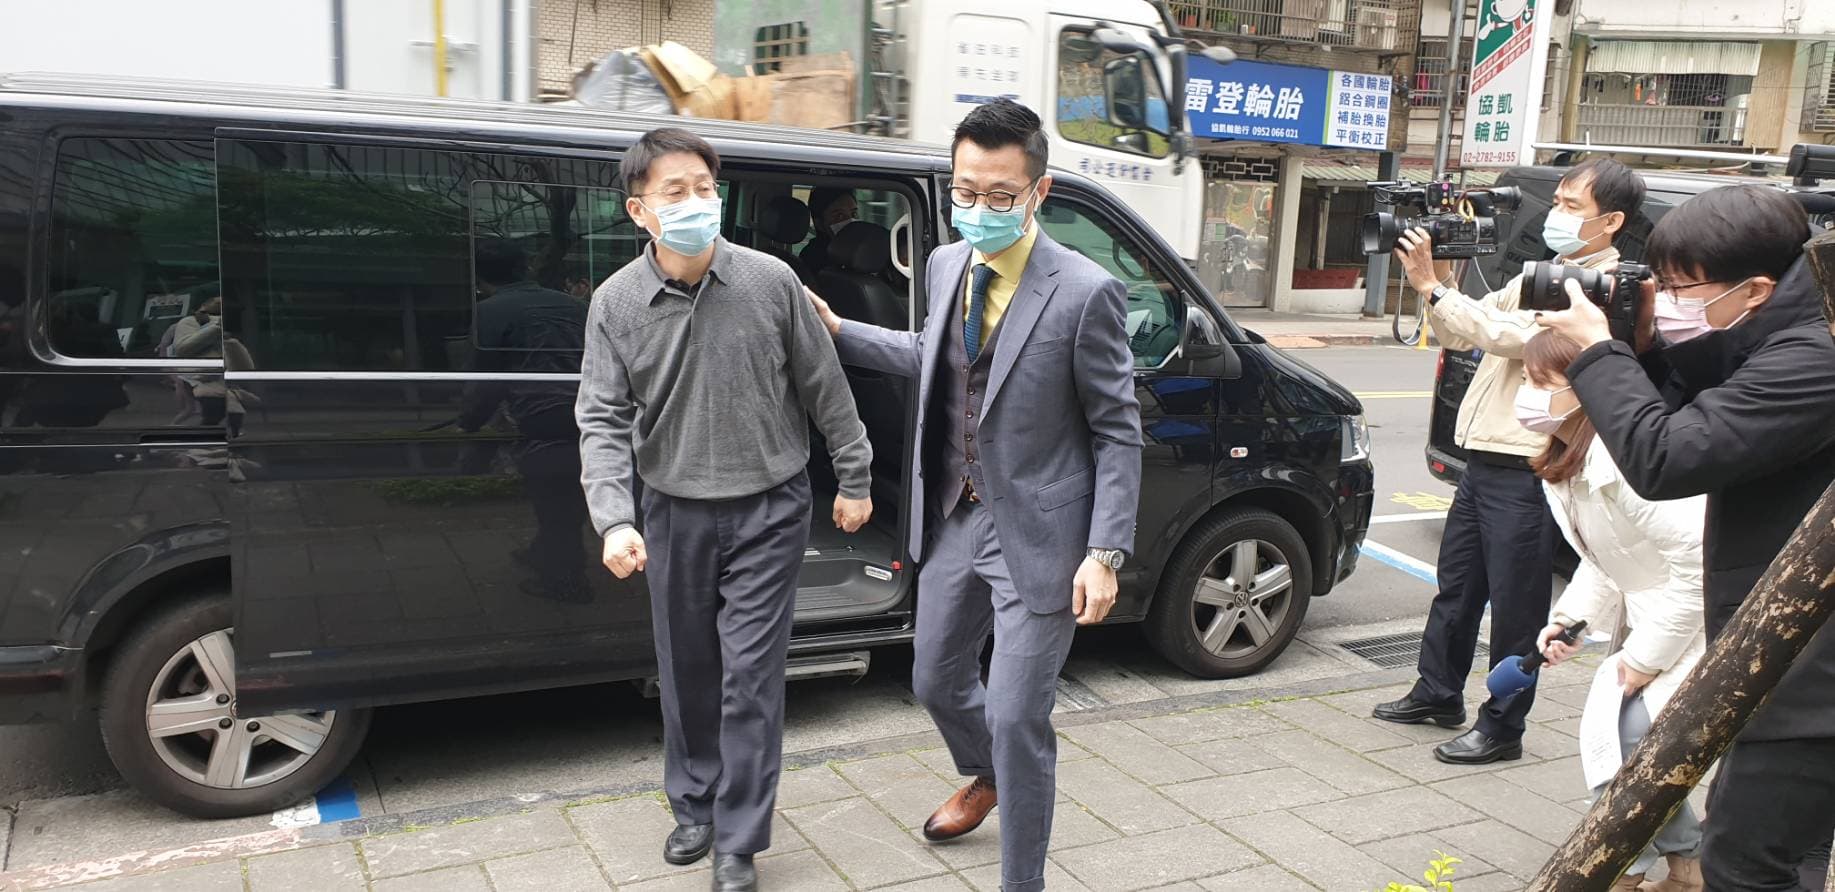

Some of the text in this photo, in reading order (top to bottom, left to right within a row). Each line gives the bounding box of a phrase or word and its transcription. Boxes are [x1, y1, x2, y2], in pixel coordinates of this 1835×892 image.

[1341, 74, 1390, 91] 各國輪胎
[1184, 78, 1304, 120] 雷登輪胎
[1339, 92, 1388, 109] 鋁合鋼圈
[1478, 93, 1512, 115] 協凱
[1337, 110, 1386, 128] 補胎換胎
[1252, 126, 1270, 137] 0952
[1271, 127, 1284, 138] 066
[1285, 128, 1298, 139] 021
[1336, 128, 1385, 145] 平衡校正
[1474, 120, 1510, 143] 輪胎
[1463, 151, 1517, 163] 02-2782-9155
